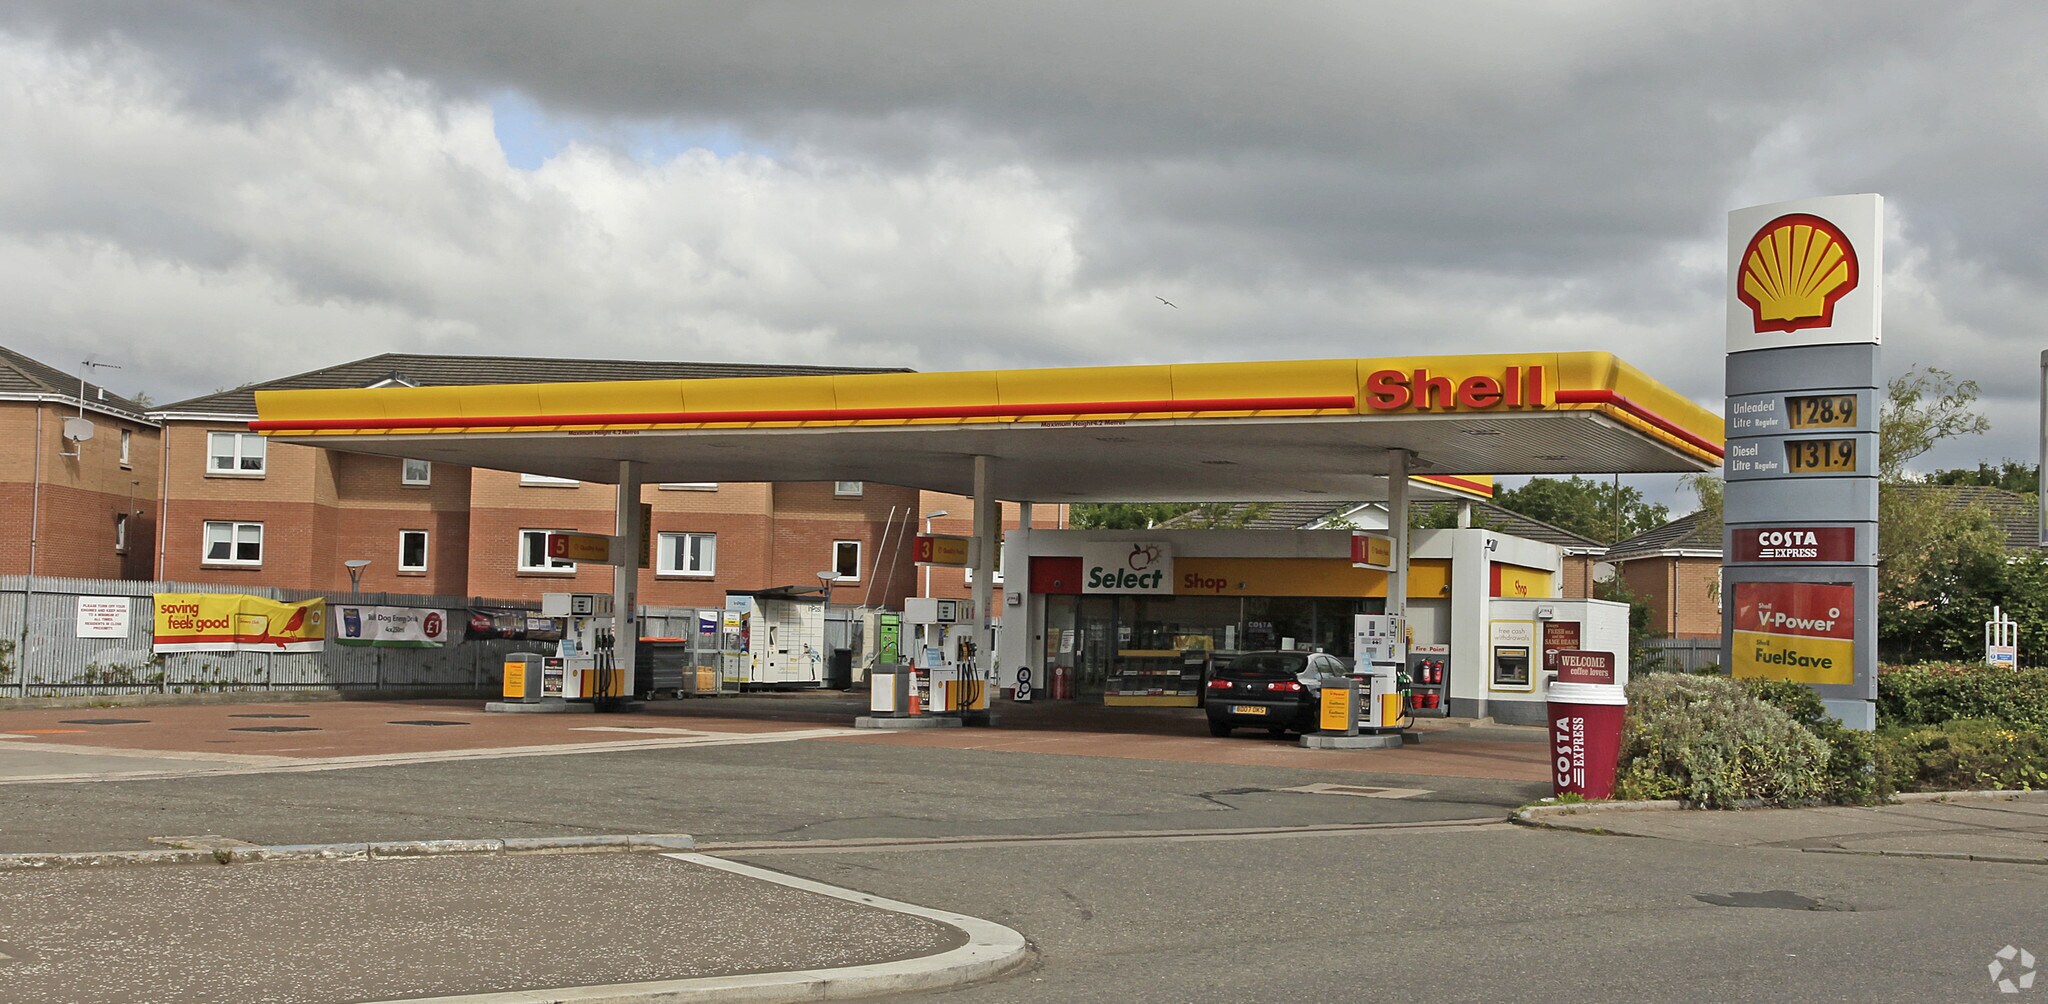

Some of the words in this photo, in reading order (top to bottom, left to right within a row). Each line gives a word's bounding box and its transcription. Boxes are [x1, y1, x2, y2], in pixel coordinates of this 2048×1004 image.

[1366, 365, 1545, 410] Shell
[1733, 399, 1775, 415] Unleaded
[1794, 398, 1853, 425] 128.9
[1733, 418, 1751, 428] Litre
[1755, 418, 1778, 428] Regular
[1732, 443, 1758, 457] Diesel
[1794, 441, 1852, 468] 131.9
[1732, 460, 1751, 471] Litre
[1755, 461, 1778, 471] Regular
[556, 538, 565, 554] 5
[1758, 531, 1818, 547] COSTA
[922, 541, 930, 558] 3
[1361, 541, 1366, 559] 1
[1775, 548, 1817, 558] EXPRESS
[1088, 567, 1163, 589] Select
[1184, 573, 1227, 593] Shop
[1514, 579, 1528, 598] Shop
[161, 600, 199, 617] saving
[168, 615, 194, 630] feels
[196, 614, 229, 633] good
[378, 614, 391, 623] Dog
[392, 615, 406, 623] Energy
[426, 620, 440, 634] £1
[1758, 610, 1835, 631] V-Power
[1562, 656, 1605, 668] WELCOME
[1755, 647, 1833, 669] FuelSave
[1570, 666, 1589, 676] coffee
[1589, 667, 1609, 677] lovers
[1573, 717, 1584, 767] EXPRESS
[1556, 717, 1572, 787] COSTA
